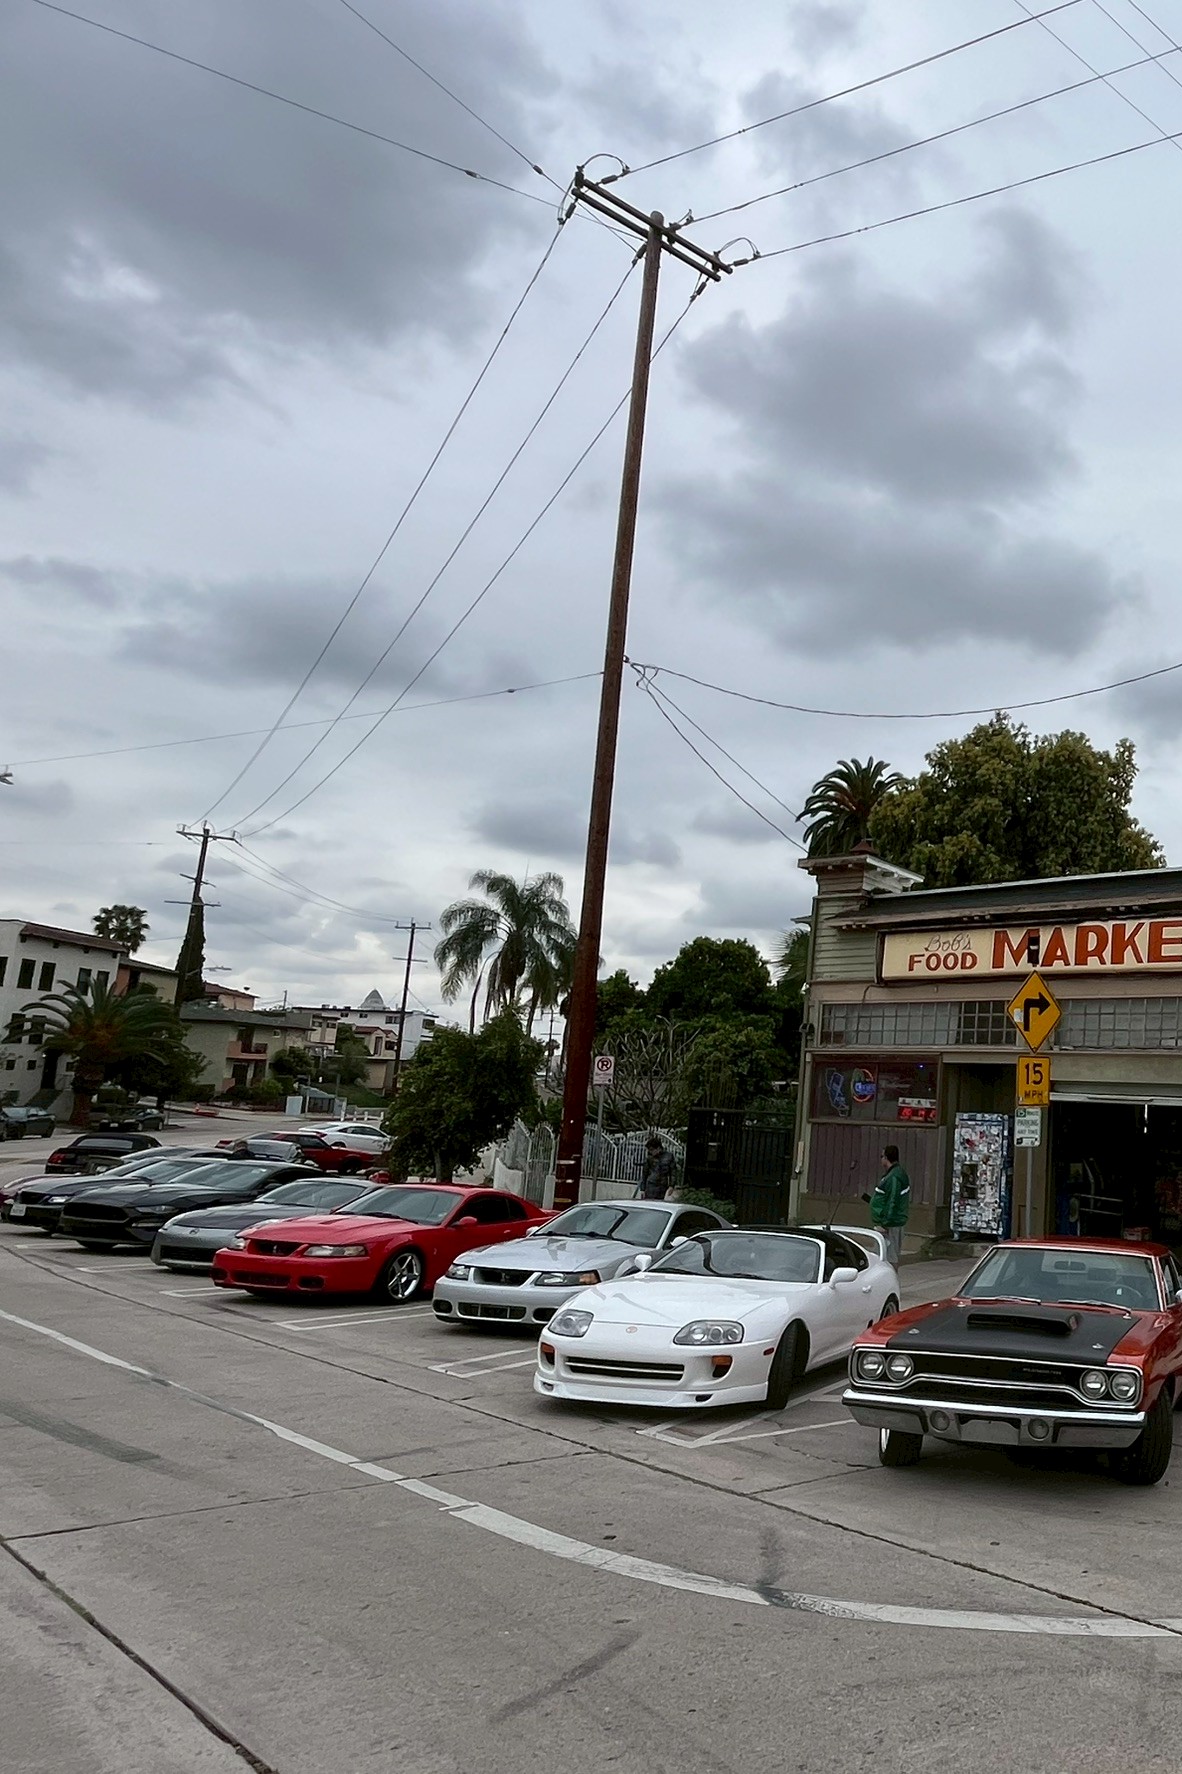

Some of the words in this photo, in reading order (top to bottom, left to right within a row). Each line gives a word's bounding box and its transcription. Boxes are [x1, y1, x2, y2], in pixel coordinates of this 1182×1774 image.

[924, 932, 971, 951] Bob's
[908, 952, 978, 971] FOOD
[1025, 1063, 1043, 1085] 15
[1024, 1090, 1043, 1099] MPH
